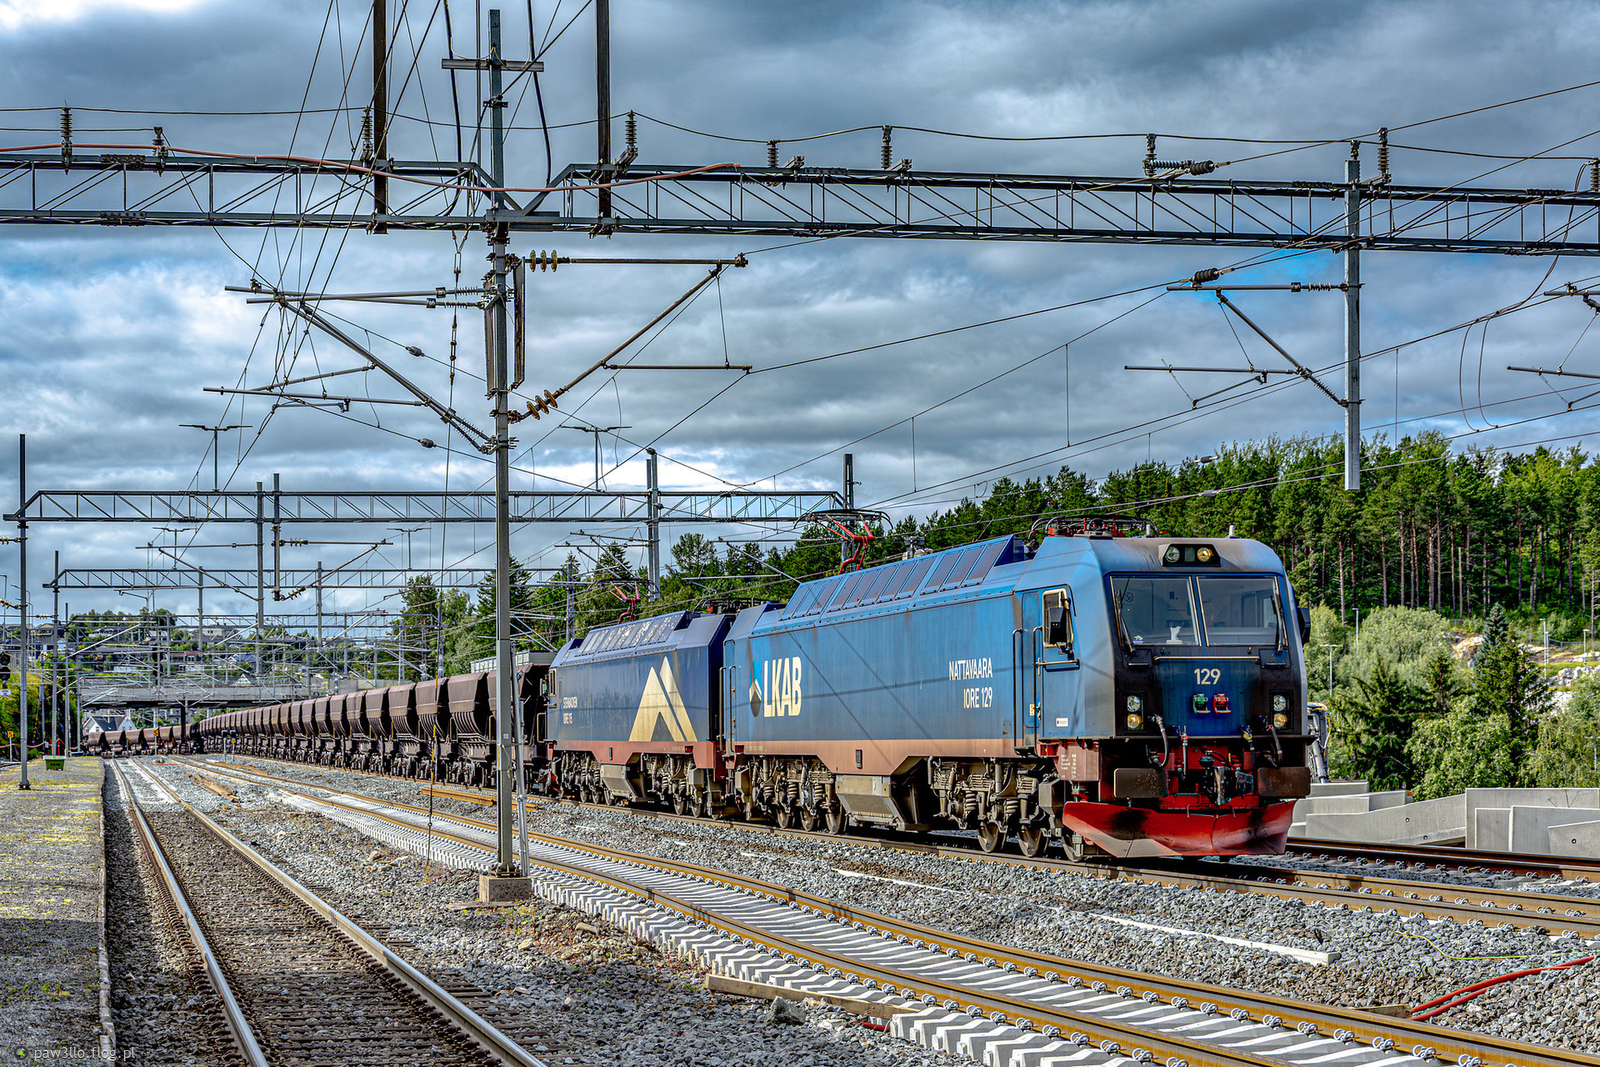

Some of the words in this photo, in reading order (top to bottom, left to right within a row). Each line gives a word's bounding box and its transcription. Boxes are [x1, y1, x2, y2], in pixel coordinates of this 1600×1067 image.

[949, 657, 993, 681] NATTAVAARA
[1194, 668, 1221, 685] 129
[763, 656, 802, 718] LKAB
[963, 687, 980, 709] IORE
[981, 686, 993, 708] 129
